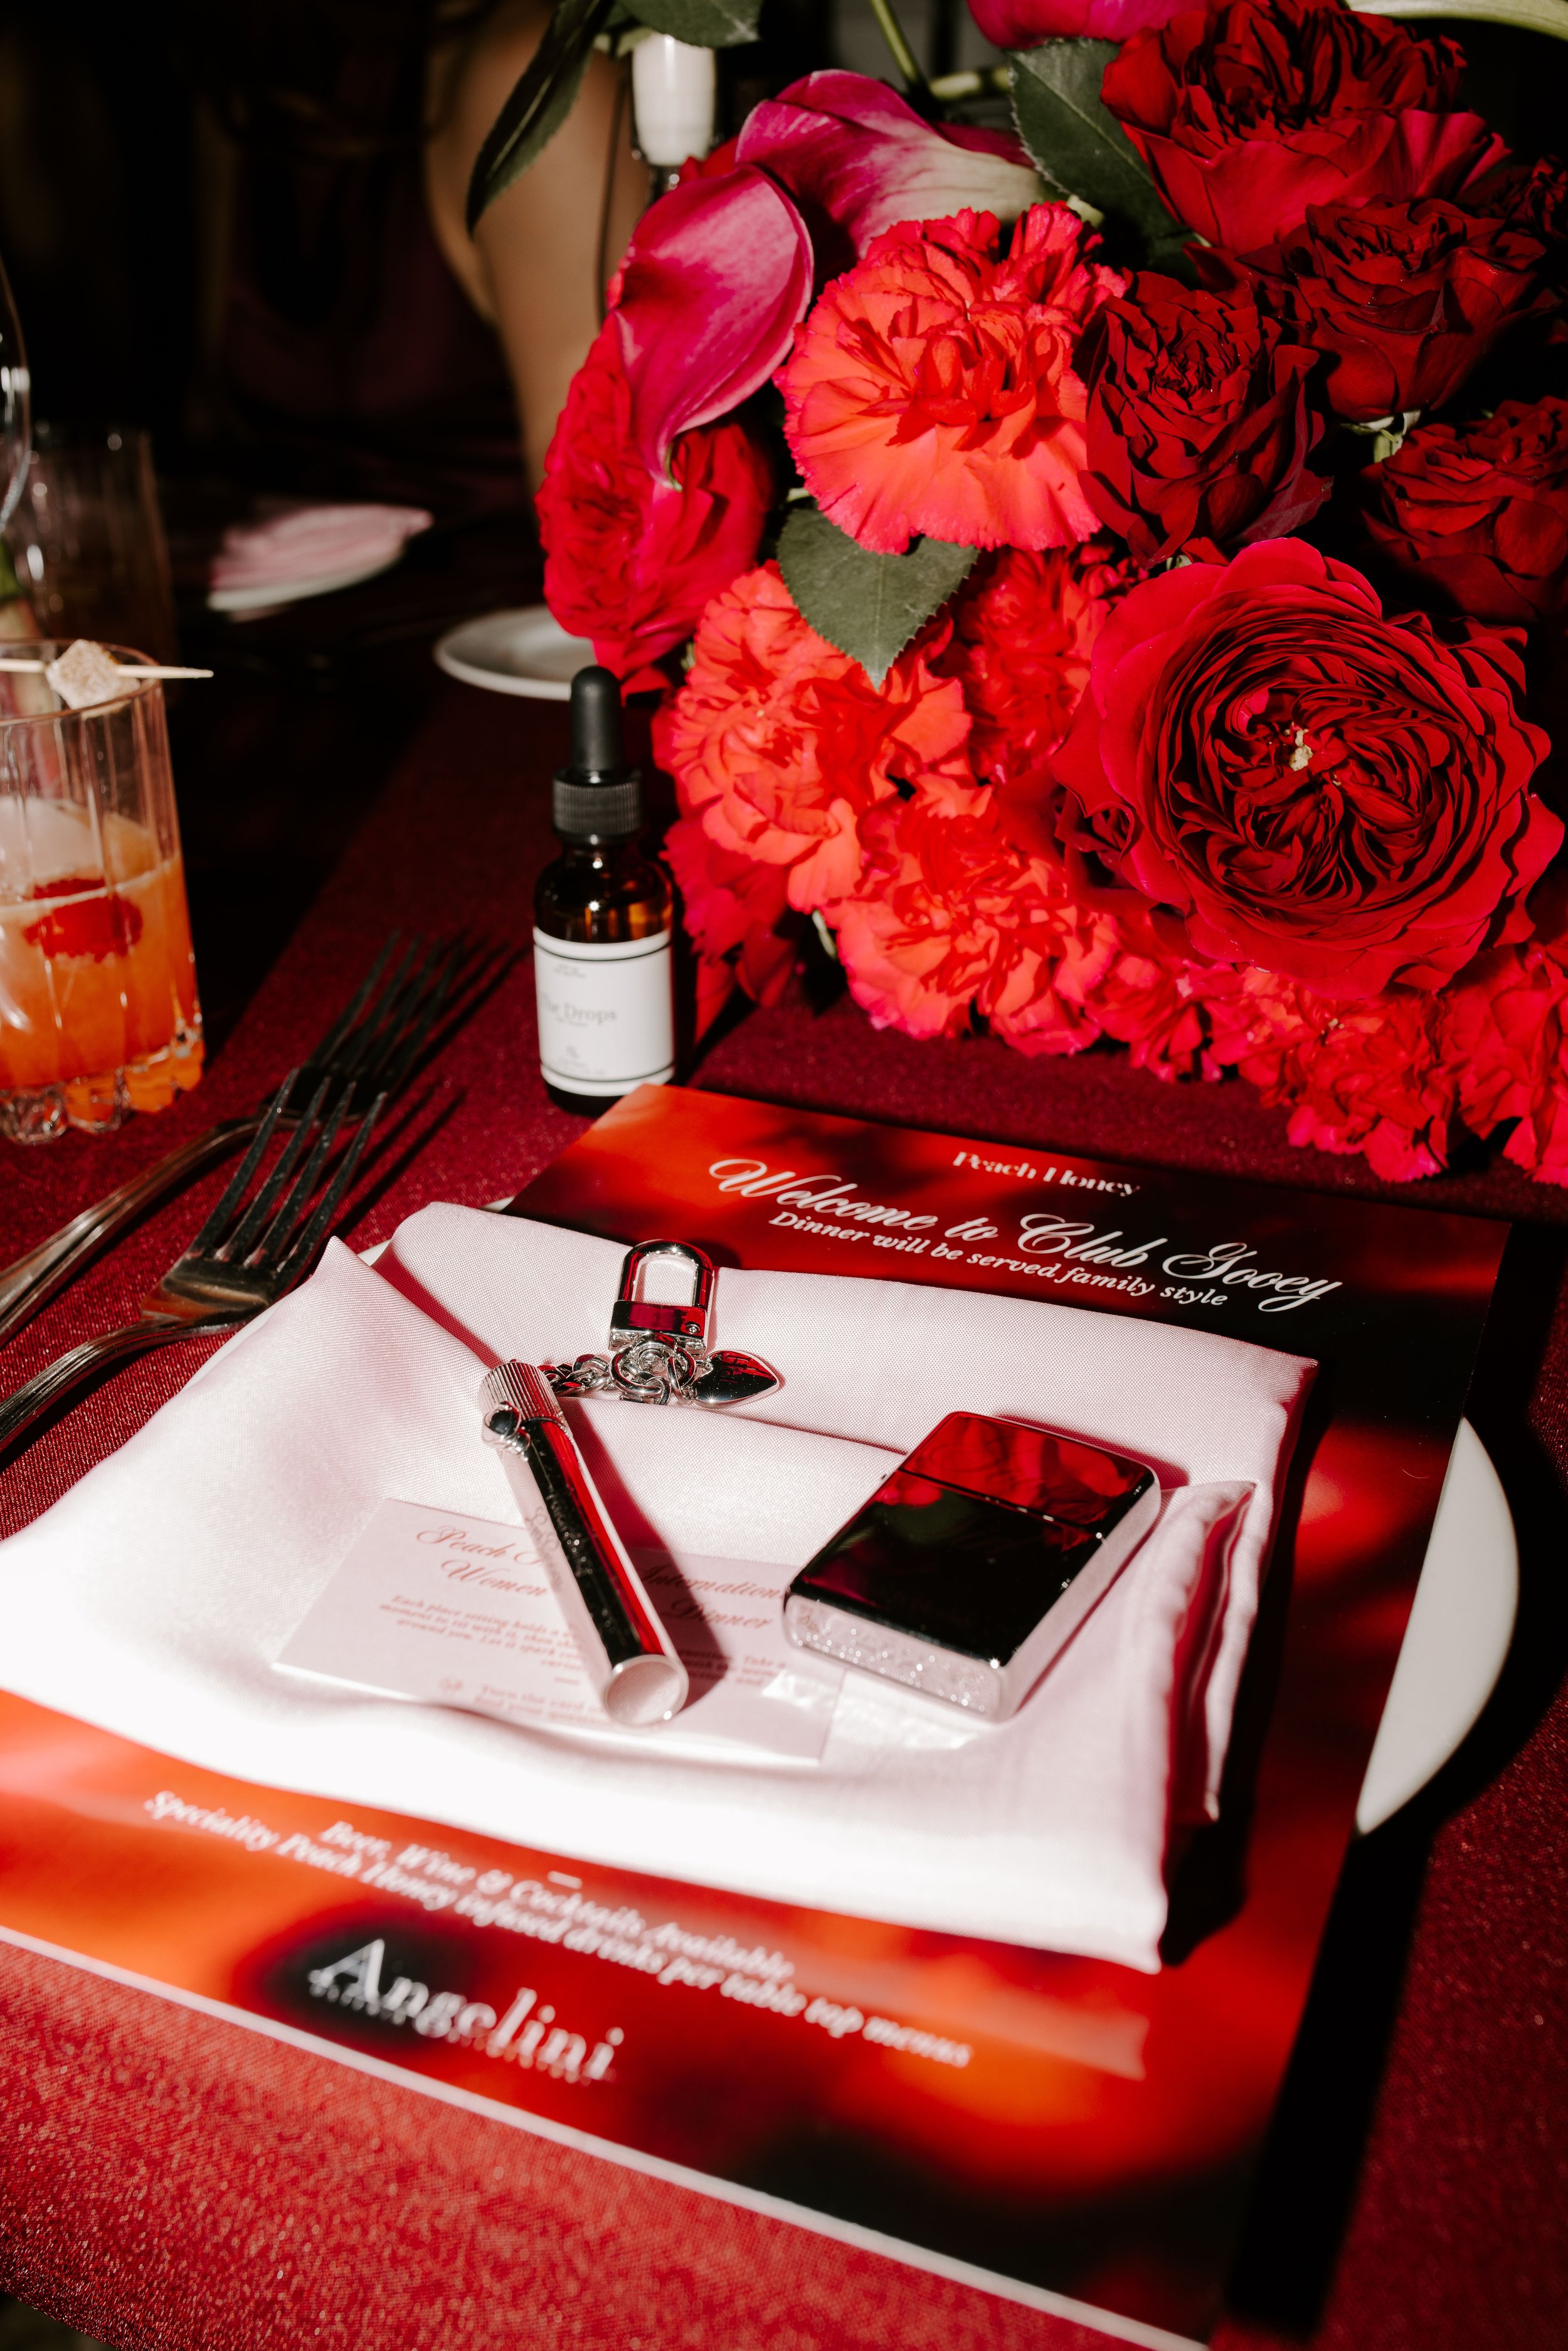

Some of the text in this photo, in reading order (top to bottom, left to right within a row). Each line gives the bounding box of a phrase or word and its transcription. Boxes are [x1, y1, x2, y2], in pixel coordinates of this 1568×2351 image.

[564, 1002, 617, 1026] Drops
[953, 1151, 1141, 1196] Peach Honey
[709, 1159, 1343, 1312] Welcome to Club Gooey
[768, 1211, 1228, 1305] Dinner will be served family style
[416, 1526, 516, 1558] Peach
[442, 1559, 547, 1596] Women
[143, 1790, 971, 2068] Speciality Peach Honey infused drinks per table top menus
[395, 1843, 476, 1885] Wine
[476, 1869, 513, 1895] &
[509, 1879, 646, 1938] Cocktails
[641, 1921, 795, 1982] Available
[308, 1938, 625, 2081] Angelini
